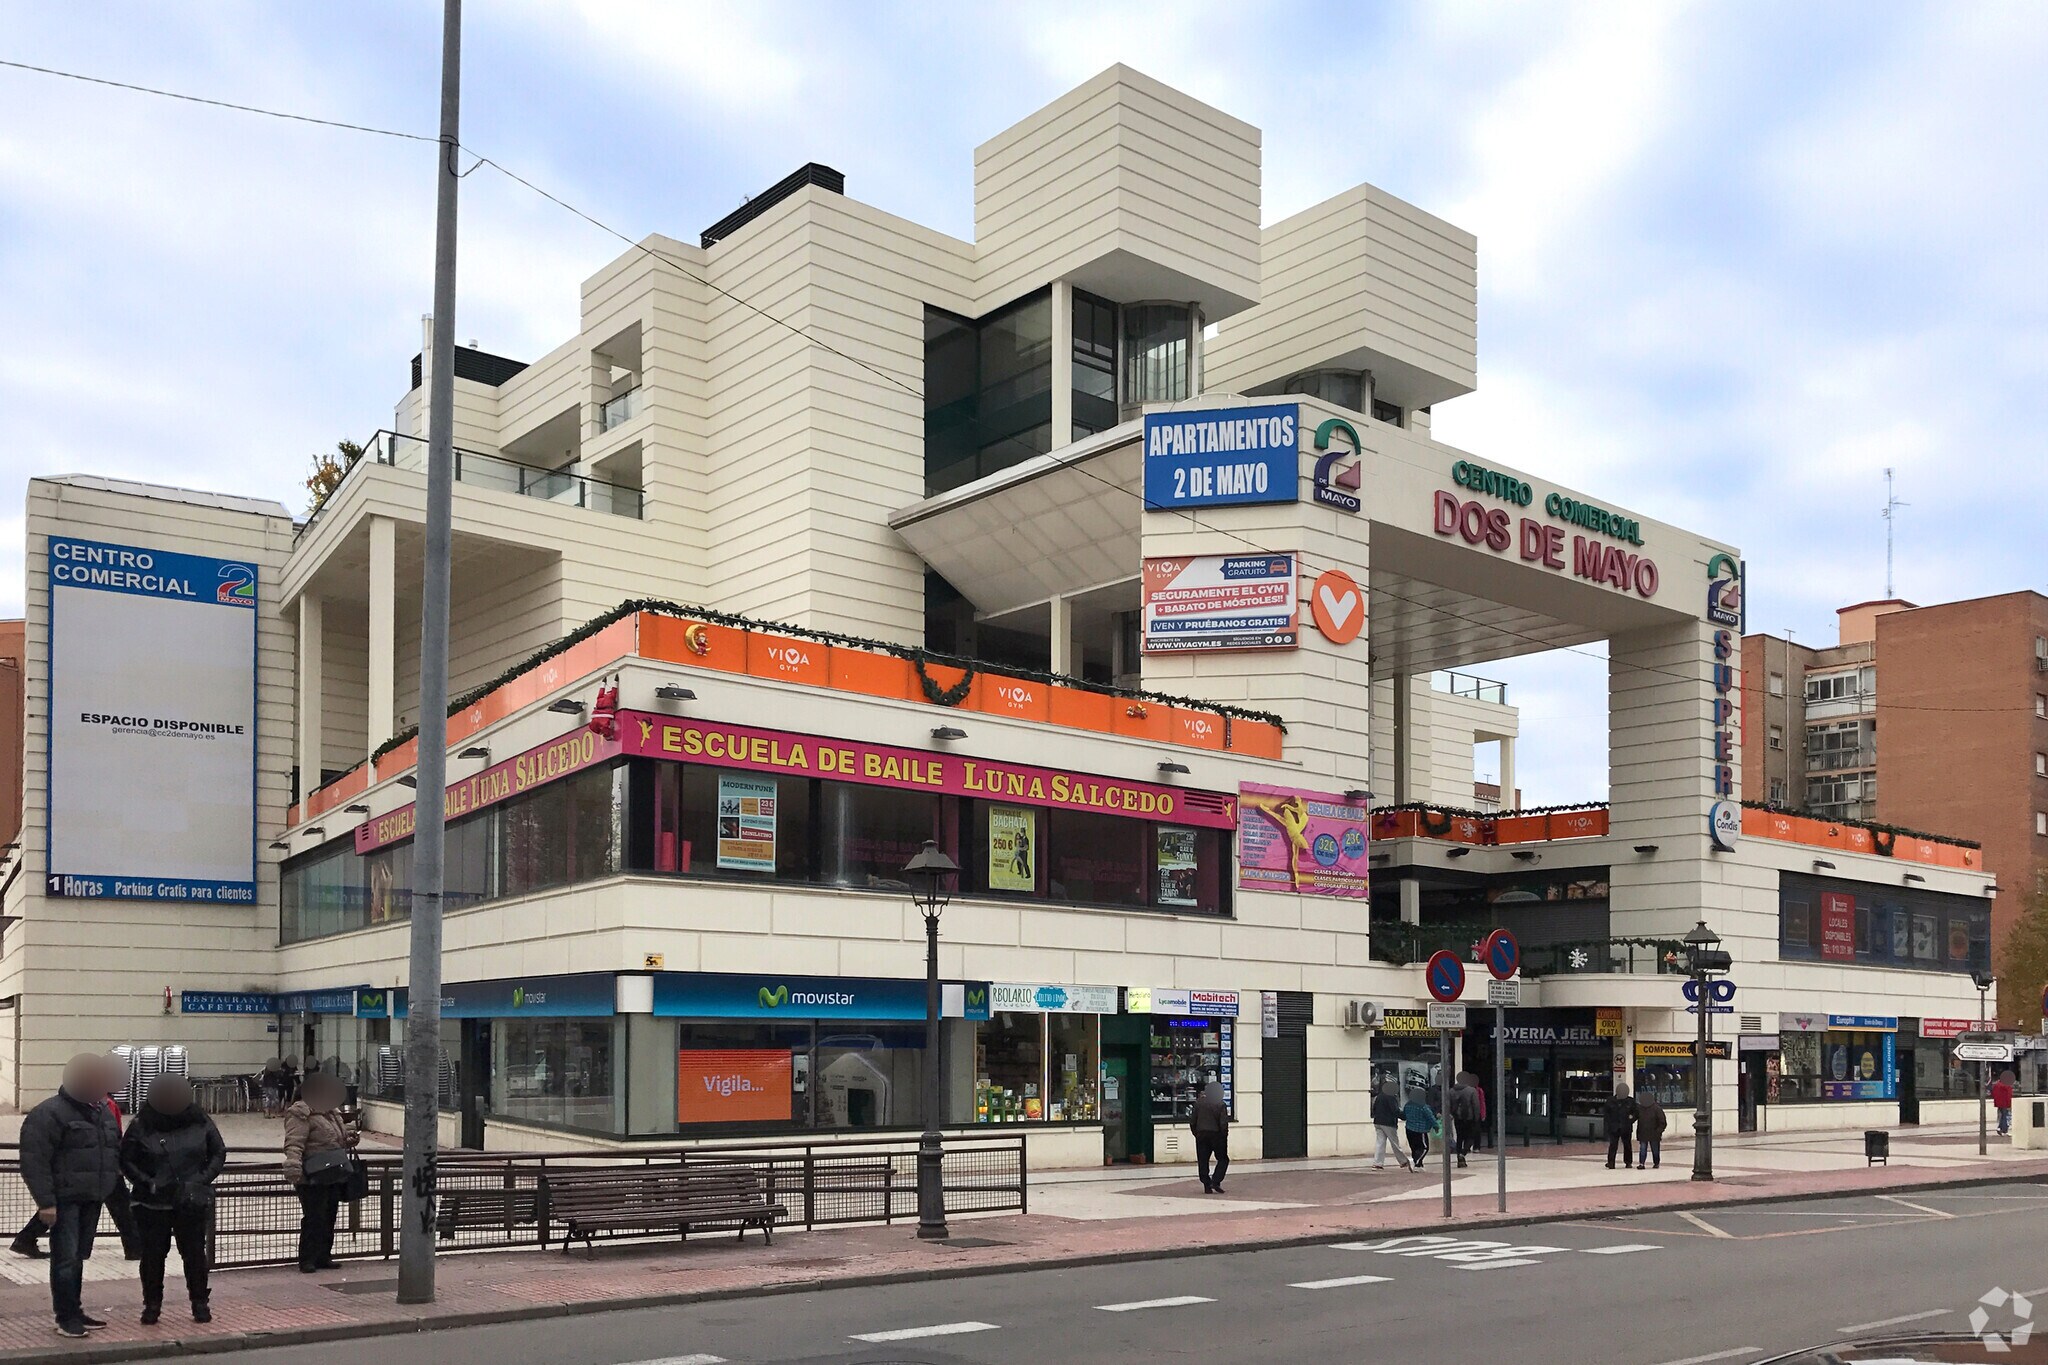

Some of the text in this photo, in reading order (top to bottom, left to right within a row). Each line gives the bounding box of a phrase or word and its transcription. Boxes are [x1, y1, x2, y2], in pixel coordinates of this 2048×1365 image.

[1149, 415, 1295, 456] APARTAMENTOS
[1174, 462, 1269, 499] 2 DE MAYO
[1320, 489, 1357, 508] MAYO
[1452, 460, 1645, 546] CENTRO COMERCIAL
[1434, 489, 1659, 598] DOS DE MAYO
[53, 543, 153, 569] CENTRO
[1147, 561, 1181, 573] VIVA
[1228, 560, 1267, 569] PARKING
[1228, 567, 1267, 577] GRATUITO
[53, 564, 197, 596] COMERCIAL
[1151, 584, 1285, 601] SEGURAMENTE EL GYM
[220, 596, 253, 605] MAYO
[1165, 602, 1207, 613] BARATO
[1207, 600, 1222, 610] DE
[1223, 594, 1284, 608] MÓSTOLES!!
[1713, 610, 1736, 624] MAYO
[1153, 616, 1287, 632] ¡VEN Y PRUÉBANOS GRATIS!
[1147, 640, 1222, 650] WWW.VIVAGYM.ES
[779, 664, 799, 673] GYM
[1007, 701, 1024, 709] GYM
[1713, 630, 1733, 795] SUPER
[81, 713, 245, 735] ESPACIO DISPONIBLE
[1191, 732, 1205, 740] GYM
[662, 726, 1174, 816] ESCUELA DE BAILE LUNA SALCEDO
[378, 730, 595, 843] ESCUELA AILE LUNA SALCEDO
[722, 781, 774, 793] MODERN FUNK
[993, 815, 1028, 829] BACHATA
[1716, 817, 1738, 832] Condis
[993, 838, 1007, 850] 250
[1318, 838, 1335, 852] 32€
[1345, 832, 1361, 845] 23€
[1314, 868, 1332, 876] CLASES
[49, 876, 253, 900] 1 Horas Parking Gratis para clientes
[1828, 918, 1848, 929] LOCALES
[183, 995, 272, 1005] RESTAURANTE
[524, 992, 547, 1004] movistar
[791, 990, 855, 1006] movistar
[993, 987, 1032, 1004] RBOLARIO
[1158, 998, 1187, 1006] Lycamobile
[1192, 992, 1236, 1003] Mobitech
[188, 1003, 269, 1012] CAFETERIA
[1597, 1009, 1621, 1019] COMPRO
[1383, 1017, 1415, 1030] ANCHO
[1601, 1020, 1616, 1028] ORO
[1490, 1027, 1556, 1039] JOYERIA
[1600, 1028, 1619, 1036] PLATA
[1643, 1045, 1691, 1054] COMPRO ORO
[703, 1074, 764, 1097] Vigila...
[1328, 1236, 1573, 1262] BUS
